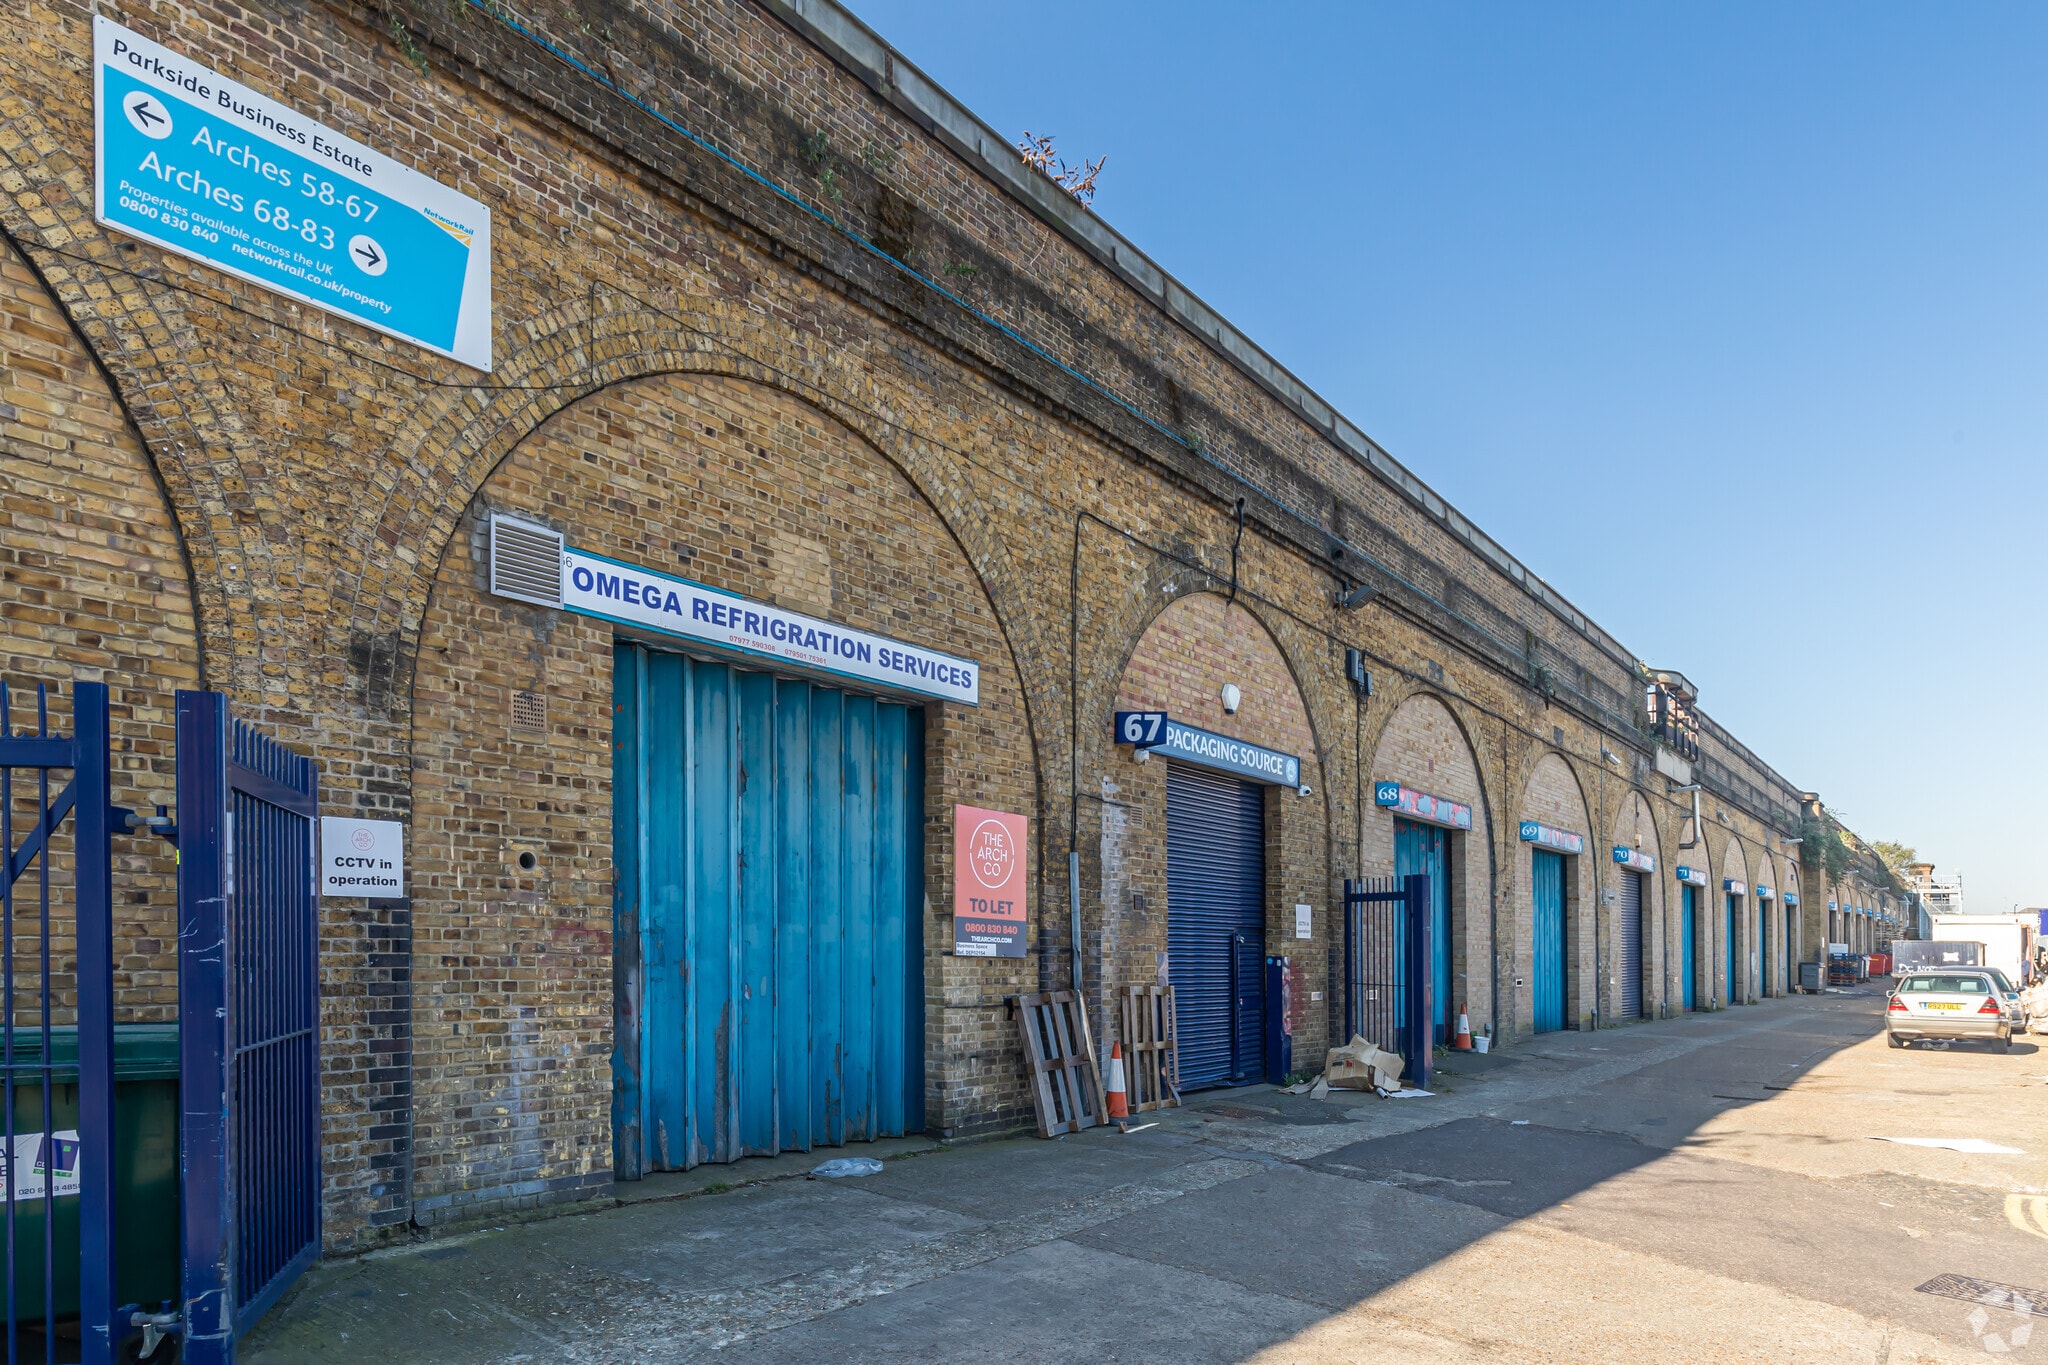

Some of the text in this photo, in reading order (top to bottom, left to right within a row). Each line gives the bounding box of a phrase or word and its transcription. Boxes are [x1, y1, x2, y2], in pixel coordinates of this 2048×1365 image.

[113, 38, 373, 177] Parkside Business Estate
[192, 126, 380, 224] Arches 58-67
[138, 151, 336, 250] Arches 68-83
[119, 180, 334, 275] Properties available across the UK
[424, 207, 475, 237] NetworkRail
[119, 196, 393, 315] 0800 830 840 networkrail.co.uk/property
[572, 566, 973, 688] OMEGA REFRIGRATION SERVICES
[729, 635, 750, 645] 07977
[752, 641, 776, 652] 590308
[784, 649, 807, 660] 079501
[1124, 714, 1162, 742] 67
[1166, 726, 1283, 776] PACKAGING SOURCE
[1378, 787, 1398, 800] 68
[1521, 824, 1537, 836] 69
[982, 831, 1003, 847] THE
[334, 856, 392, 869] CCTV in
[977, 846, 1008, 863] ARCH
[1614, 850, 1628, 859] 70
[984, 863, 1000, 877] CO
[1678, 869, 1688, 877] 71
[329, 875, 397, 886] operation
[969, 898, 1014, 915] TO LET
[965, 923, 1018, 935] 0800 830 840
[971, 935, 1012, 944] THEARCHCO.COM
[37, 1185, 59, 1193] 89
